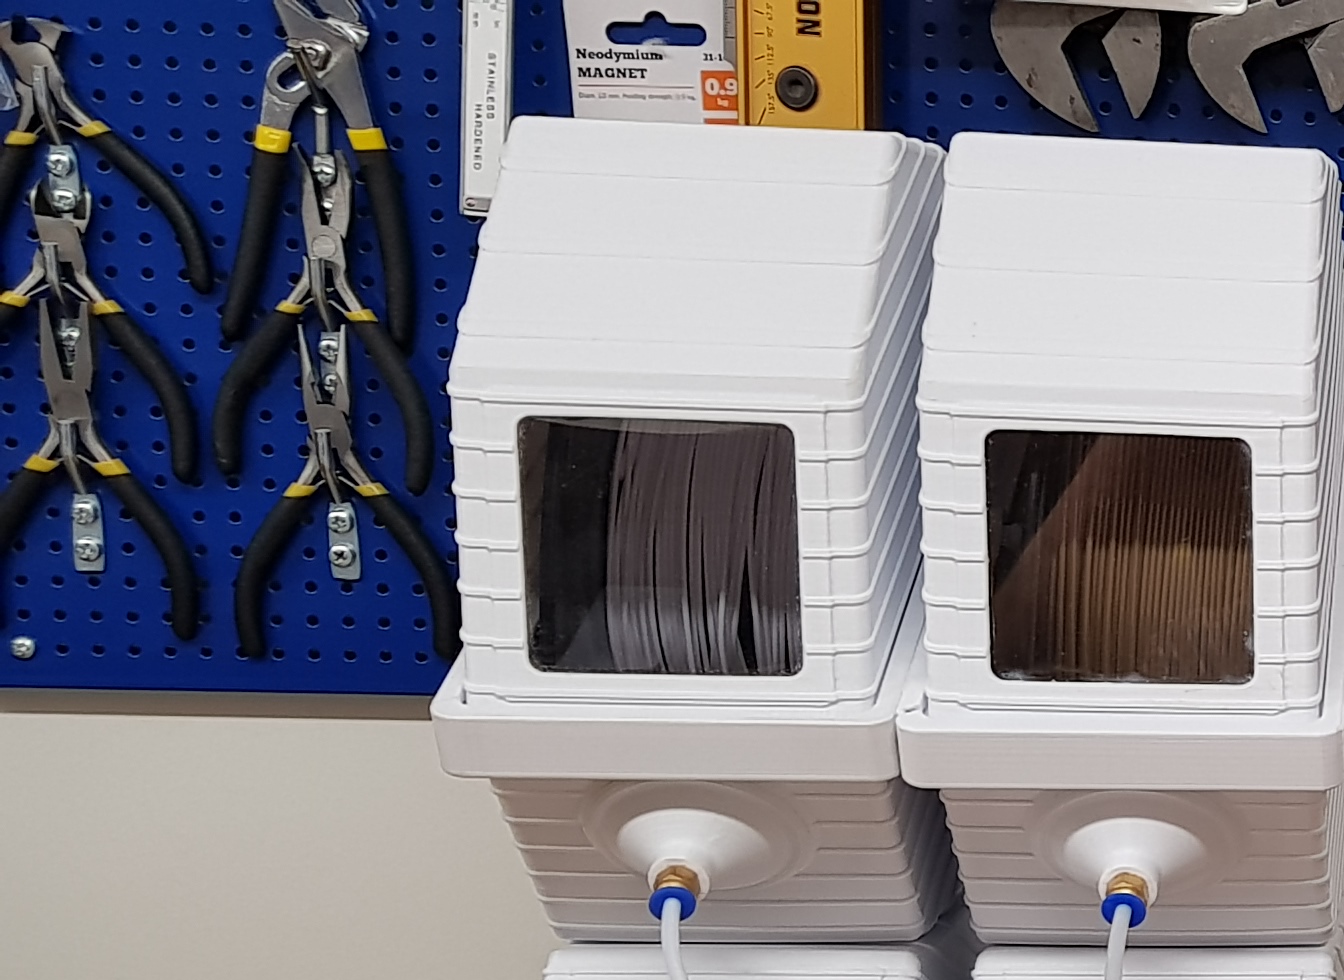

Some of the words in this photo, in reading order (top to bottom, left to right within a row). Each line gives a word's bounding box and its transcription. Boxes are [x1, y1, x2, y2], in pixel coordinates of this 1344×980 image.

[575, 48, 663, 62] Neodymium
[577, 67, 648, 79] MAGNET
[704, 77, 737, 96] 0.9
[472, 103, 484, 171] HARDENED
